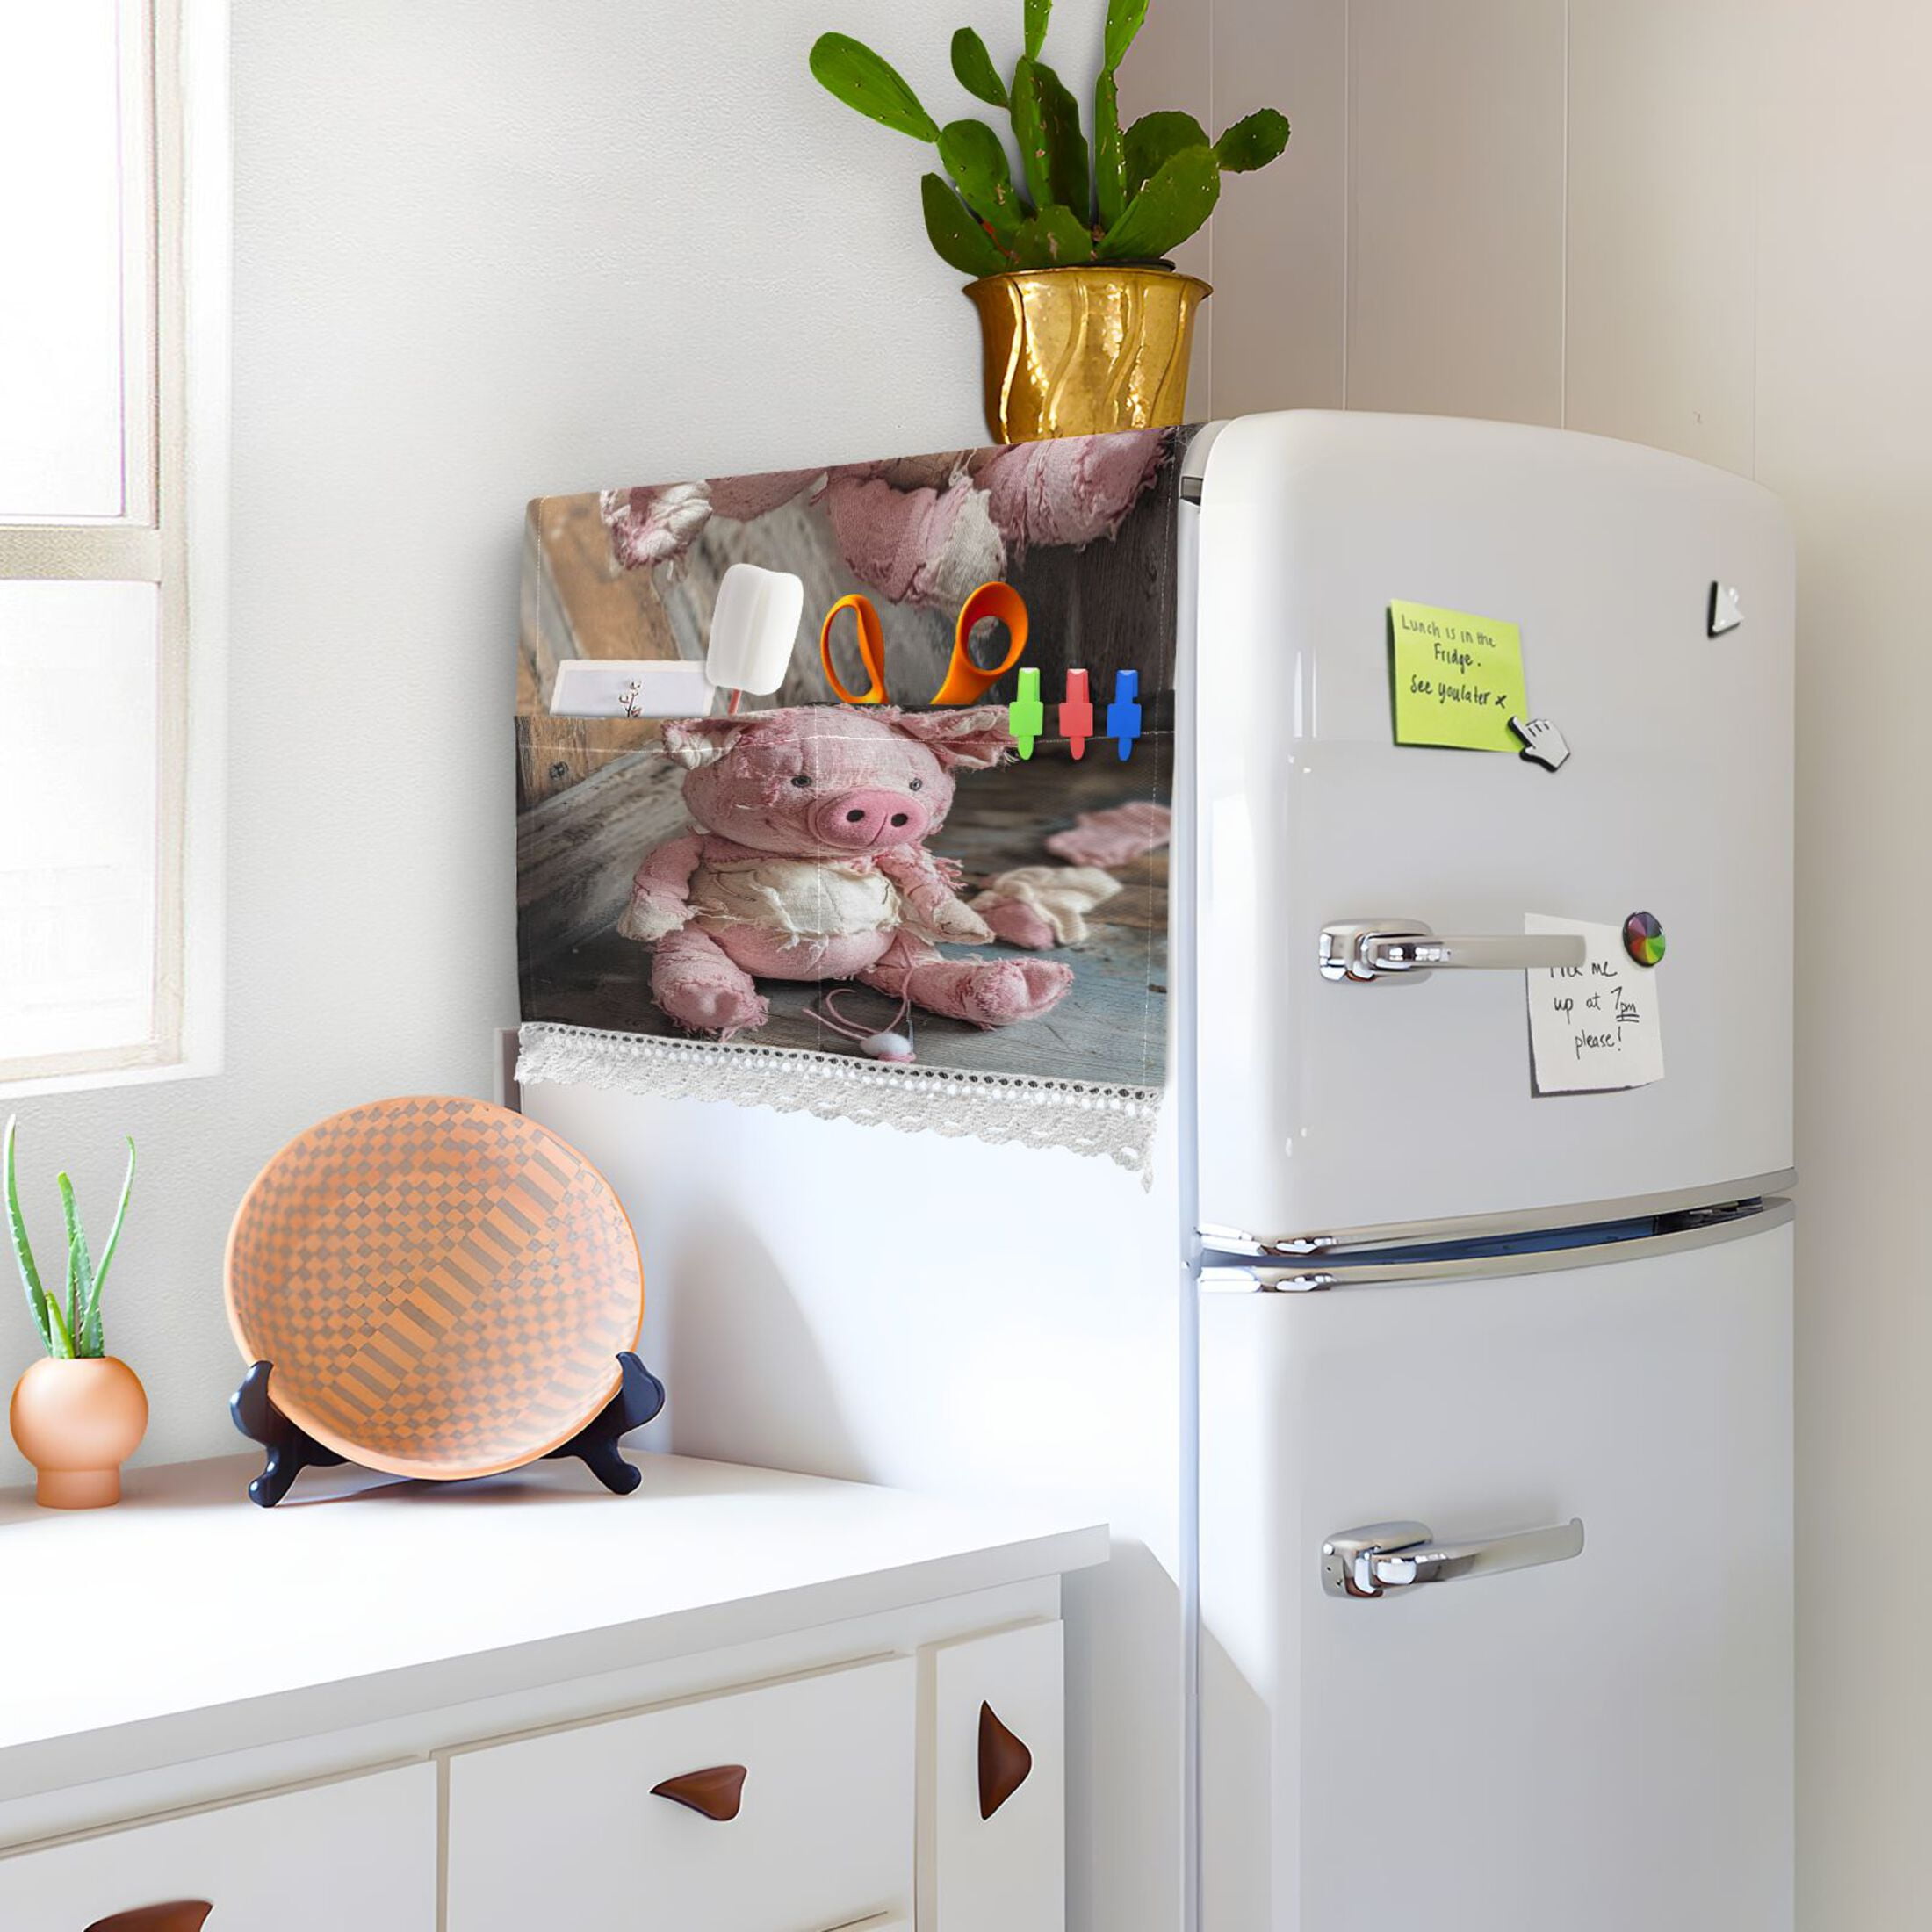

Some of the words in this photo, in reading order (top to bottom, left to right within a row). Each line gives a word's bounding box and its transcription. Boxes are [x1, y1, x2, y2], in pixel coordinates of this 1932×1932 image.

[1401, 614, 1440, 638] Lunch
[1445, 627, 1456, 640] is
[1460, 631, 1474, 643] in
[1476, 631, 1496, 648] the
[1410, 674, 1433, 694] See
[1592, 961, 1618, 977] me
[1554, 997, 1574, 1024] up
[1586, 992, 1601, 1011] at
[1575, 1026, 1622, 1060] please!
